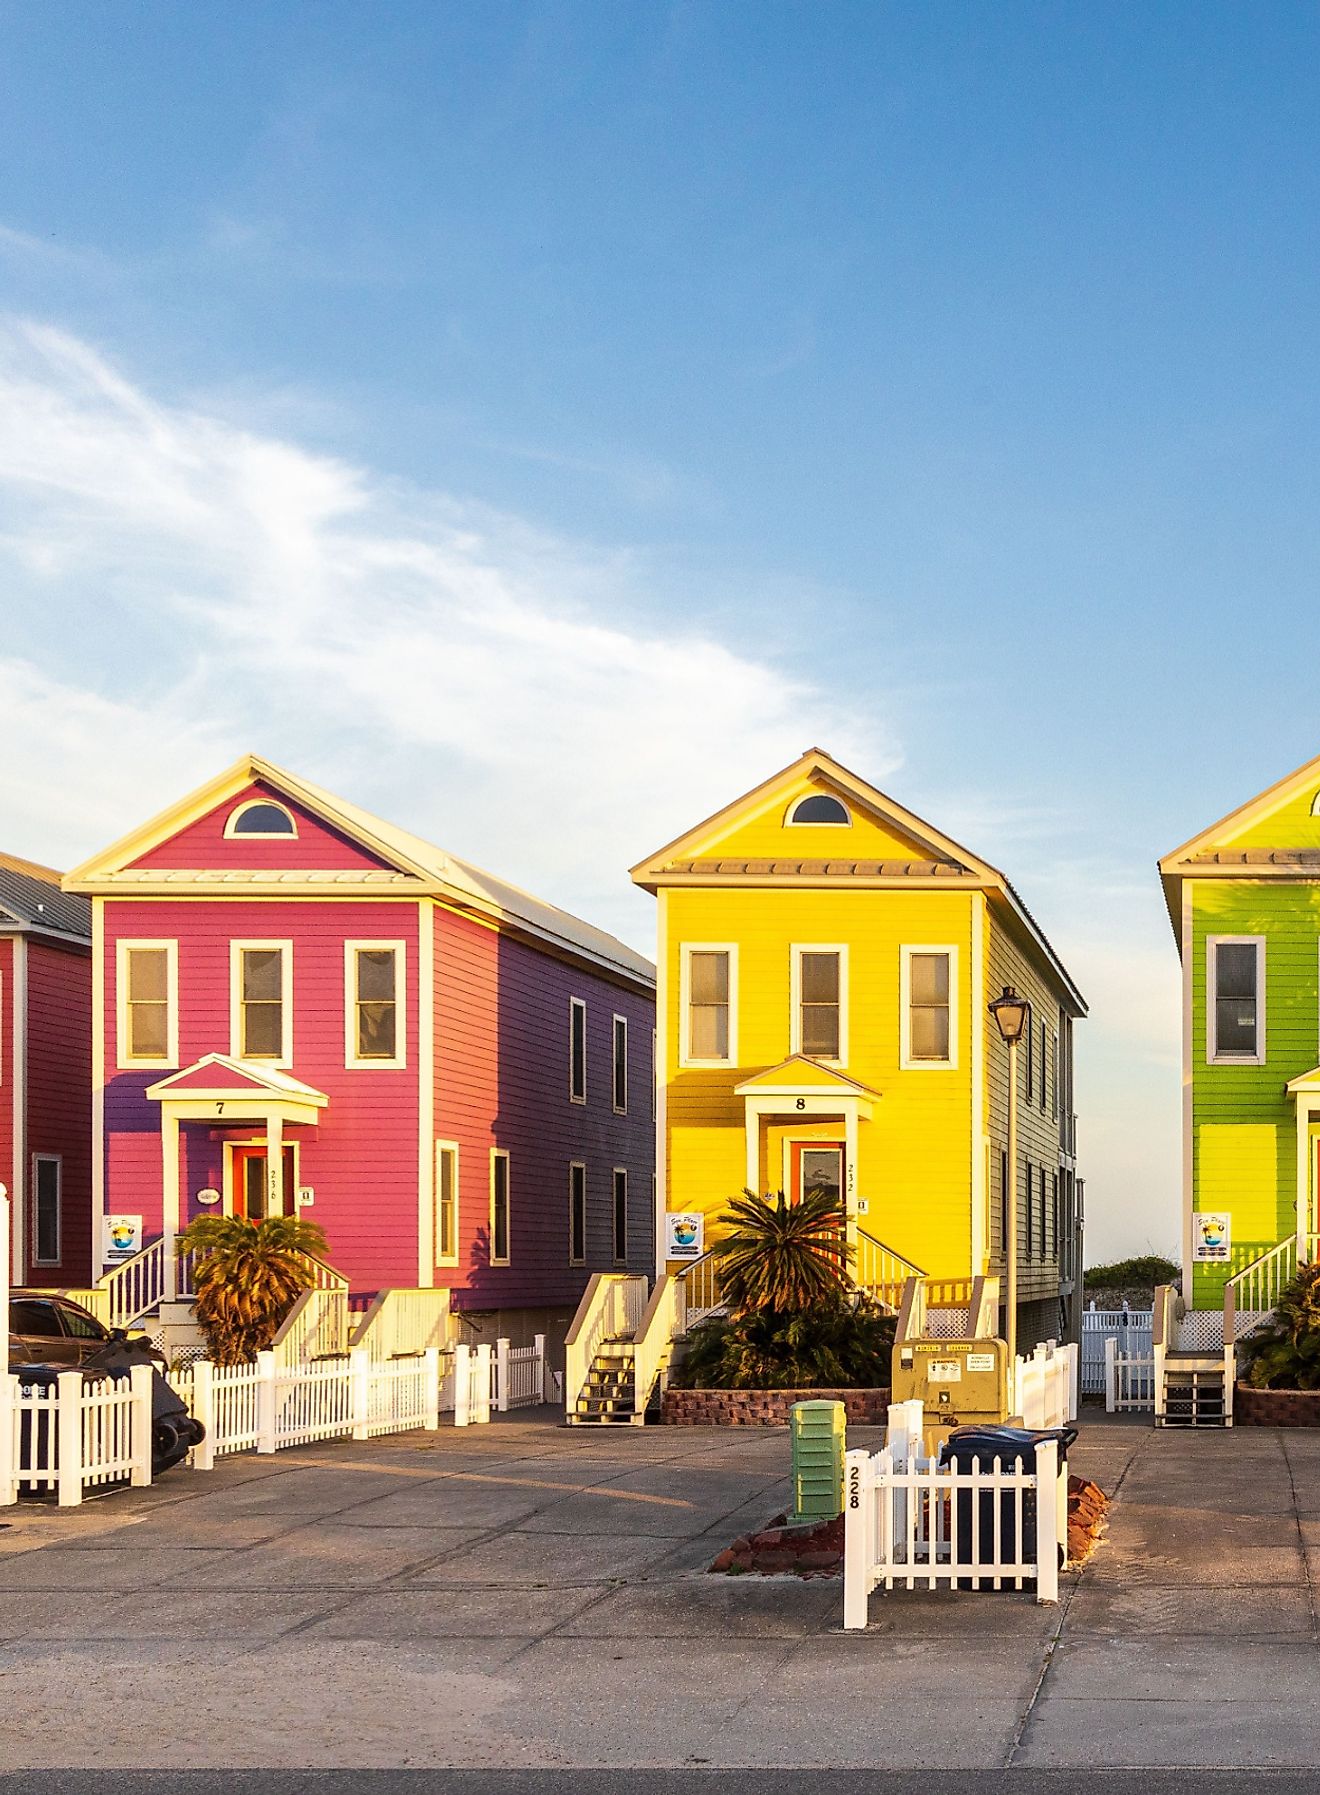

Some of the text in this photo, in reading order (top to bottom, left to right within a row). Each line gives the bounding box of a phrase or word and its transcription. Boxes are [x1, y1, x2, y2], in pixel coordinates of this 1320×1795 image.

[216, 1102, 225, 1115] 7
[796, 1098, 806, 1111] 8
[850, 1466, 859, 1508] 228
